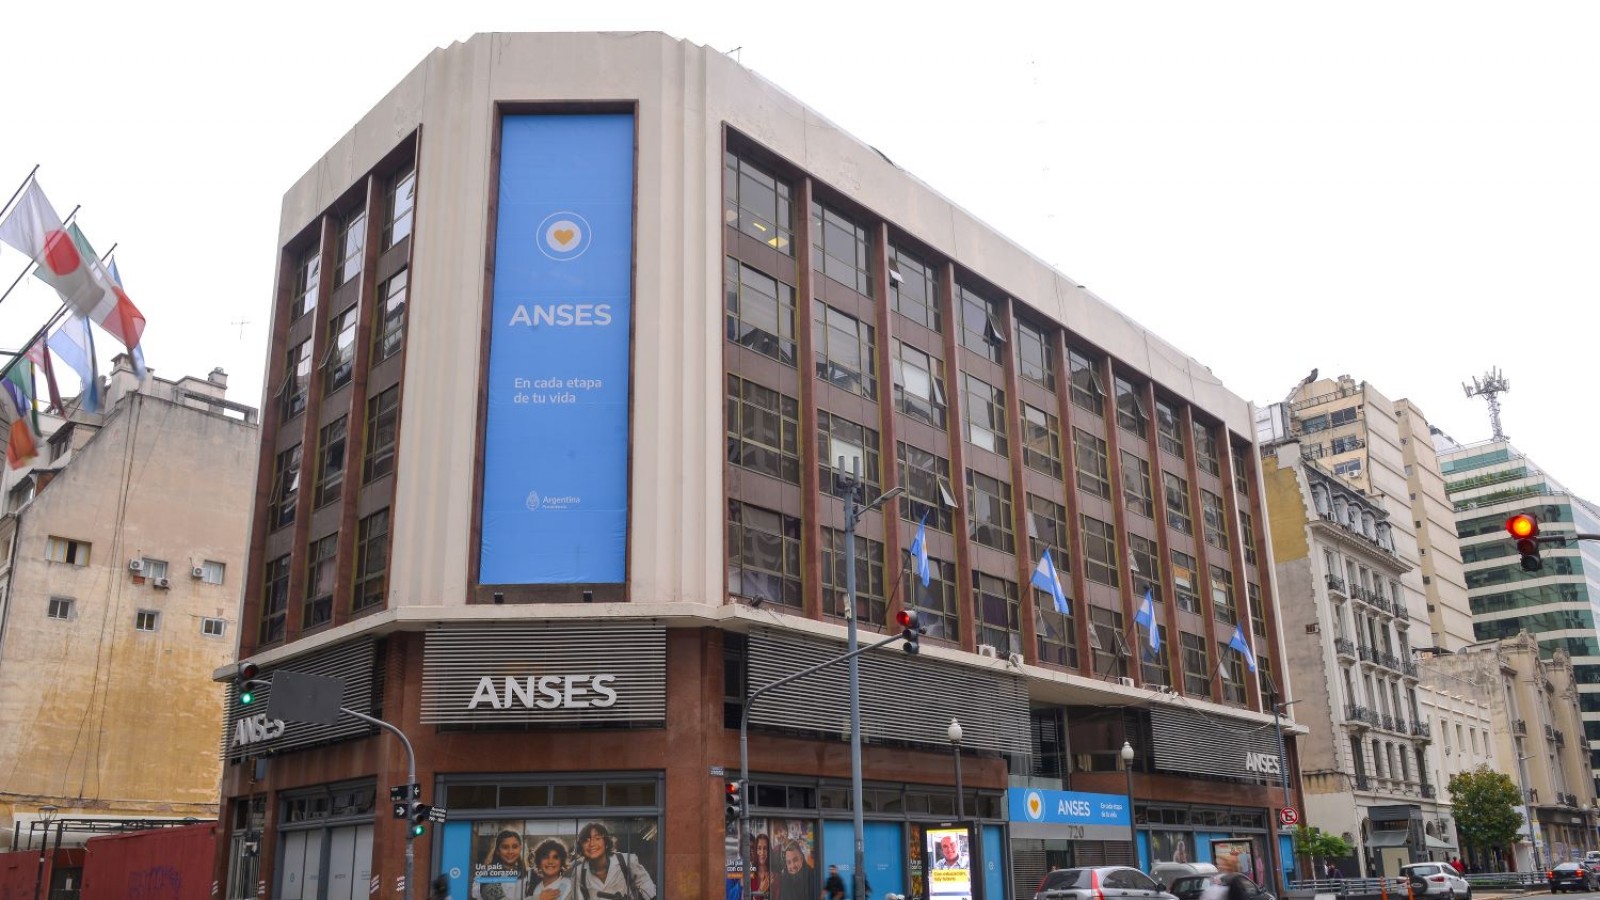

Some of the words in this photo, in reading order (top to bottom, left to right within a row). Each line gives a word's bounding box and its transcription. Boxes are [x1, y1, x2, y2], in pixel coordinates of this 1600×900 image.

[509, 304, 612, 327] ANSES
[515, 378, 530, 388] En
[535, 377, 563, 388] cada
[567, 378, 602, 390] etapa
[514, 392, 529, 403] de
[533, 393, 546, 403] tu
[549, 392, 576, 403] vida
[543, 496, 581, 505] Argentina
[468, 674, 618, 709] ANSES
[232, 713, 285, 745] ANSES
[1246, 752, 1282, 774] ANSES
[1058, 800, 1091, 817] ANSES
[1068, 825, 1084, 838] 720
[487, 863, 503, 871] país
